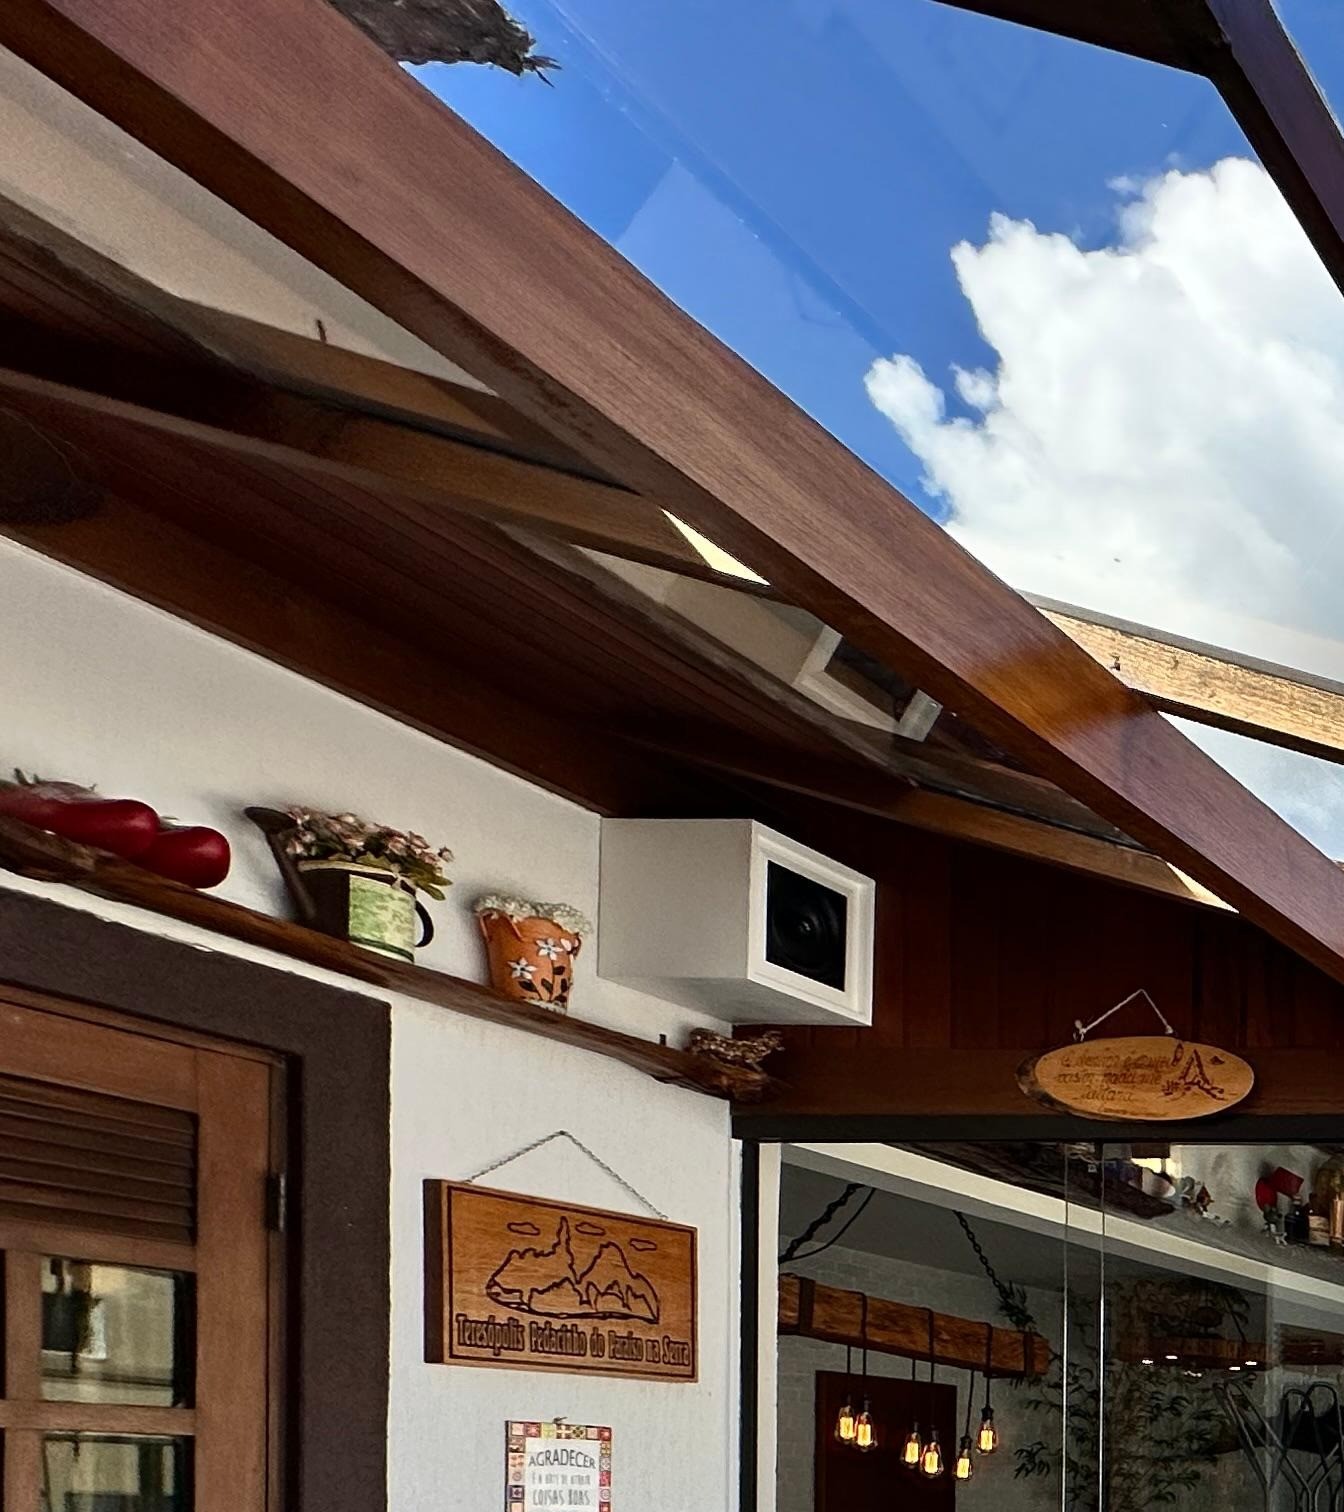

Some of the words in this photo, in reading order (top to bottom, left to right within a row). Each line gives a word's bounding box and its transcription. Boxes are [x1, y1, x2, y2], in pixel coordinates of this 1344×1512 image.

[456, 1313, 525, 1356] Teresópolis
[529, 1320, 587, 1357] Pedacinho
[591, 1327, 605, 1357] do
[608, 1330, 644, 1361] Paraíso
[645, 1339, 661, 1363] na
[662, 1335, 690, 1366] Serra
[528, 1448, 597, 1469] AGRADECER
[532, 1489, 565, 1506] COISAS
